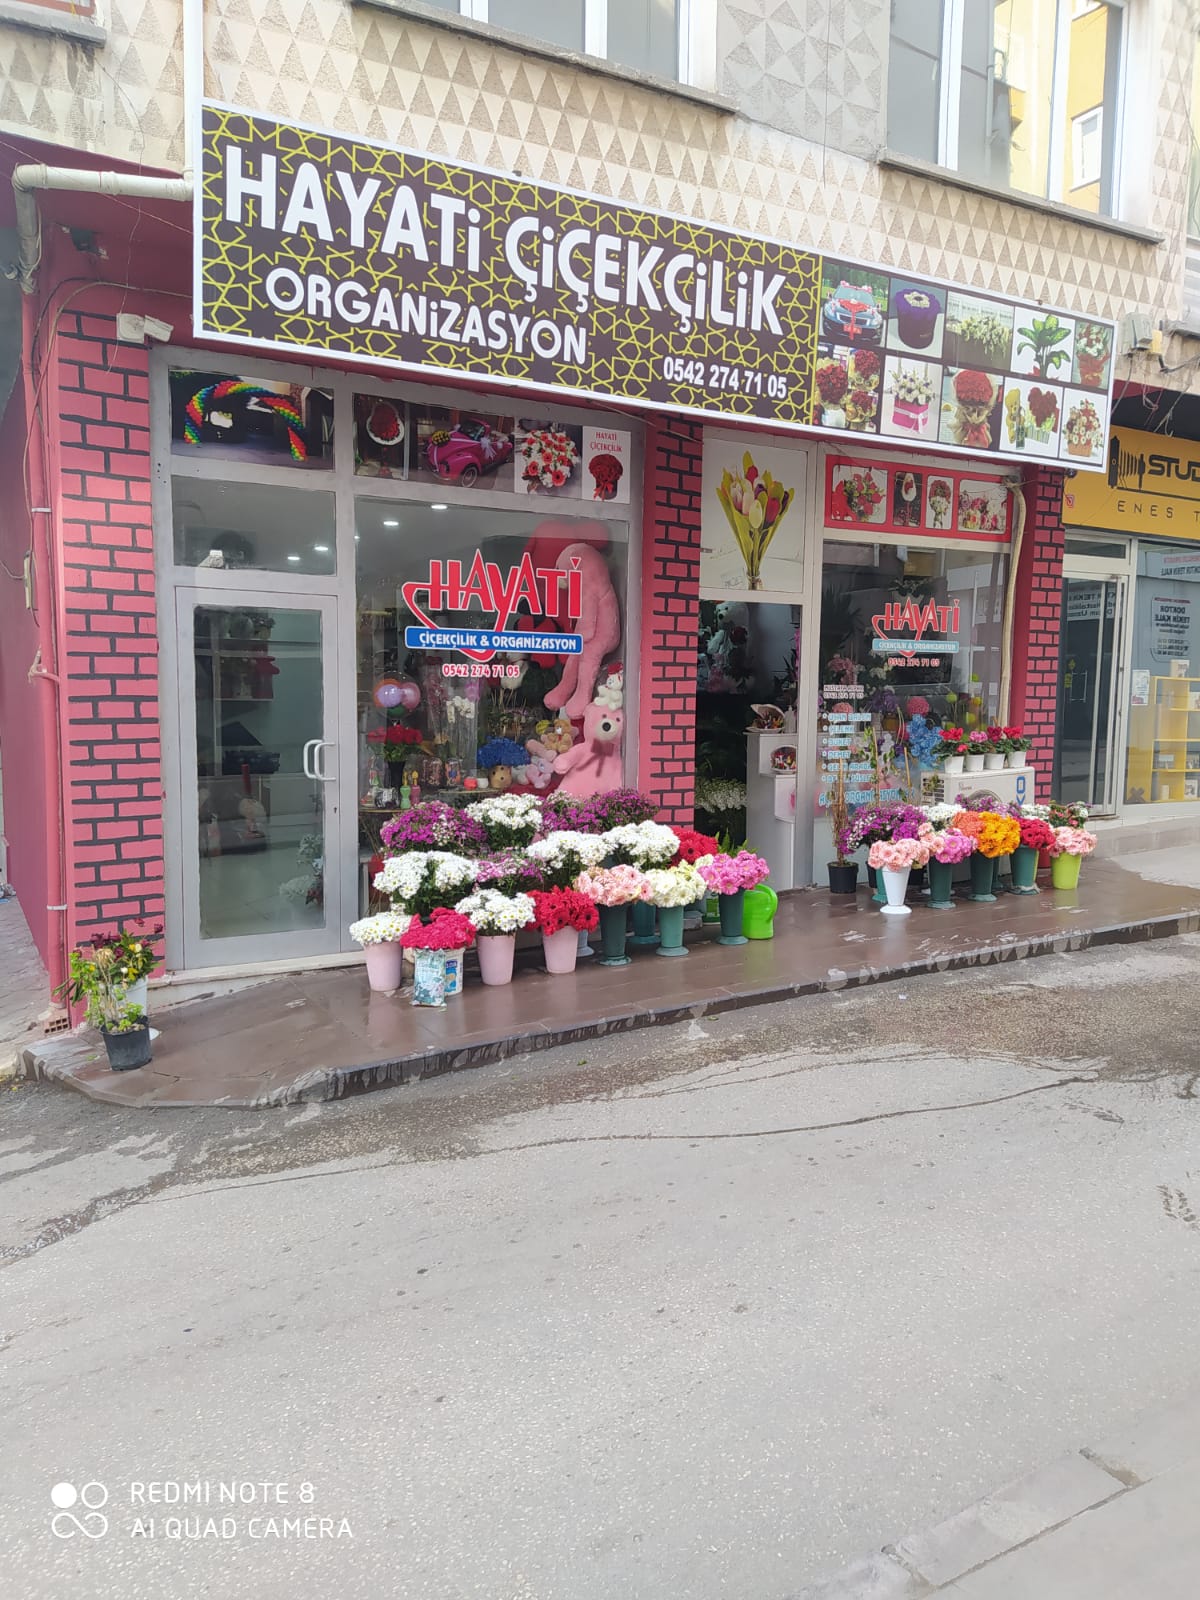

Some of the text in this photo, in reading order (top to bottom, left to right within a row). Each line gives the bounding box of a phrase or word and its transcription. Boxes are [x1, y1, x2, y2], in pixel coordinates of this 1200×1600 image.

[663, 356, 788, 399] 0542 274 71 05
[1117, 500, 1174, 518] ENES
[402, 548, 582, 632] HAYATİ
[872, 597, 960, 640] HAYATİ
[419, 631, 577, 650] ÇİÇEKÇİLİK & ORGANİZASYON
[442, 663, 520, 678] 0542 274 71 05
